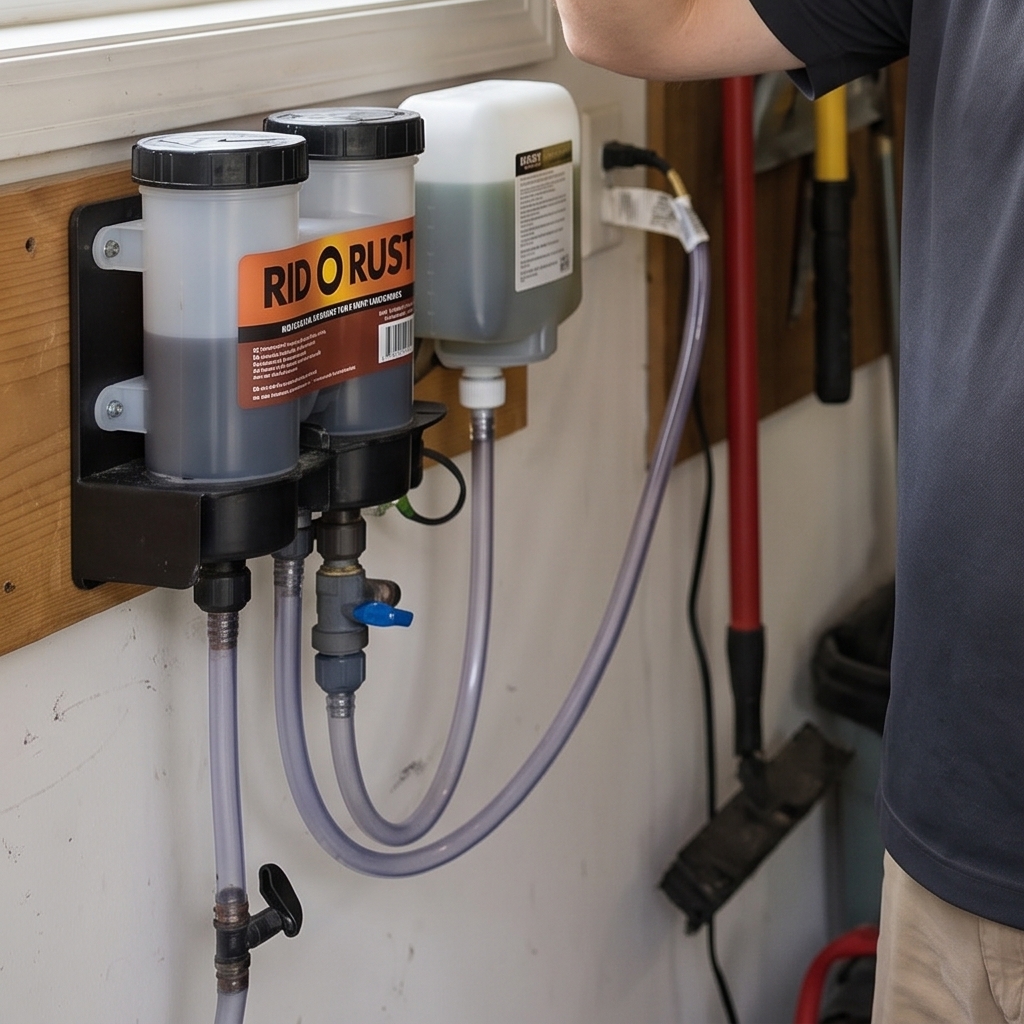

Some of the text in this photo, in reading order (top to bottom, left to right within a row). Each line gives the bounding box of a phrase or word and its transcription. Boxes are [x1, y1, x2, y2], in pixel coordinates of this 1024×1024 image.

[264, 230, 414, 309] RID O RUST
